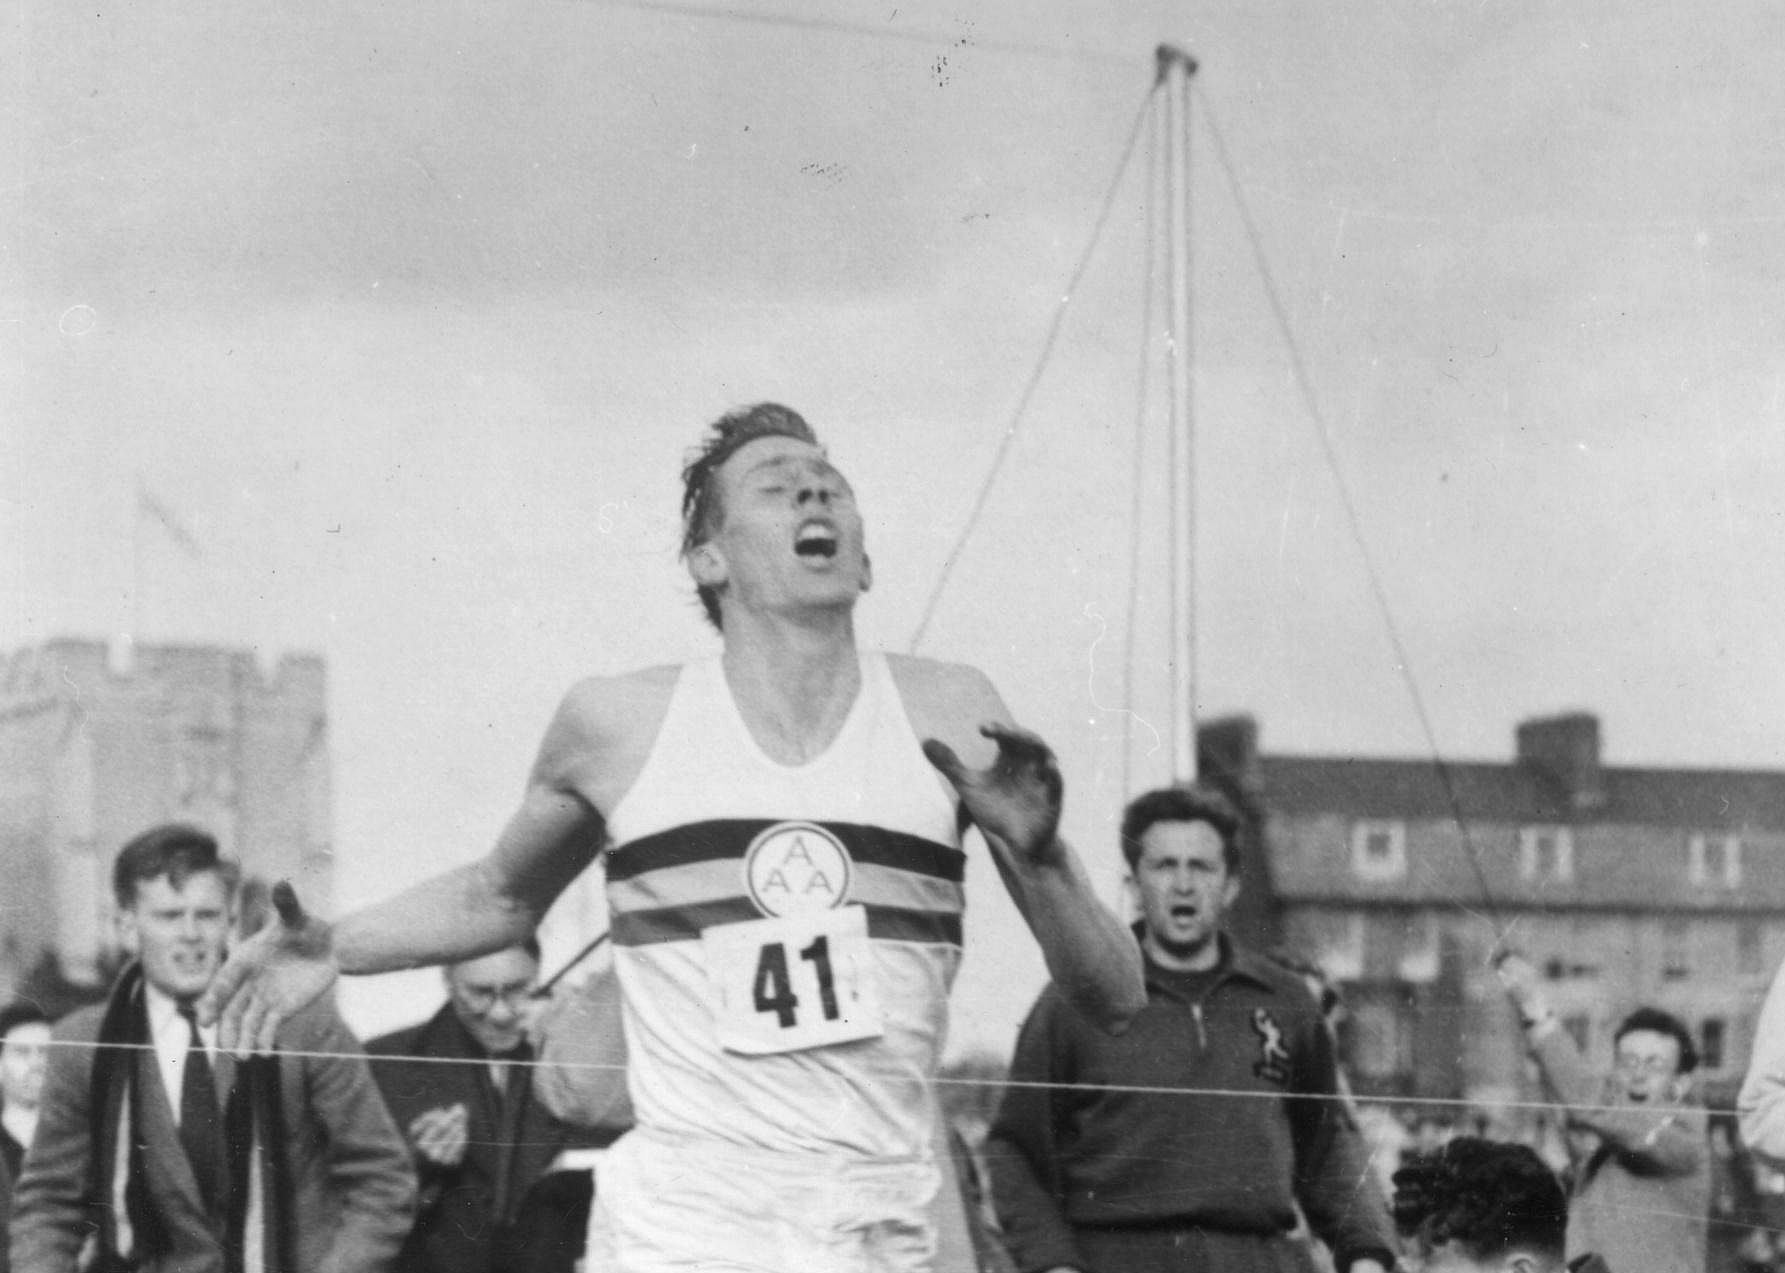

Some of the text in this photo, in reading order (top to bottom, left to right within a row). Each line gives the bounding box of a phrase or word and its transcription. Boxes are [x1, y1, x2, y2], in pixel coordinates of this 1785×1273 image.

[783, 835, 814, 865] A
[761, 867, 834, 894] A A
[753, 935, 839, 1028] 41
